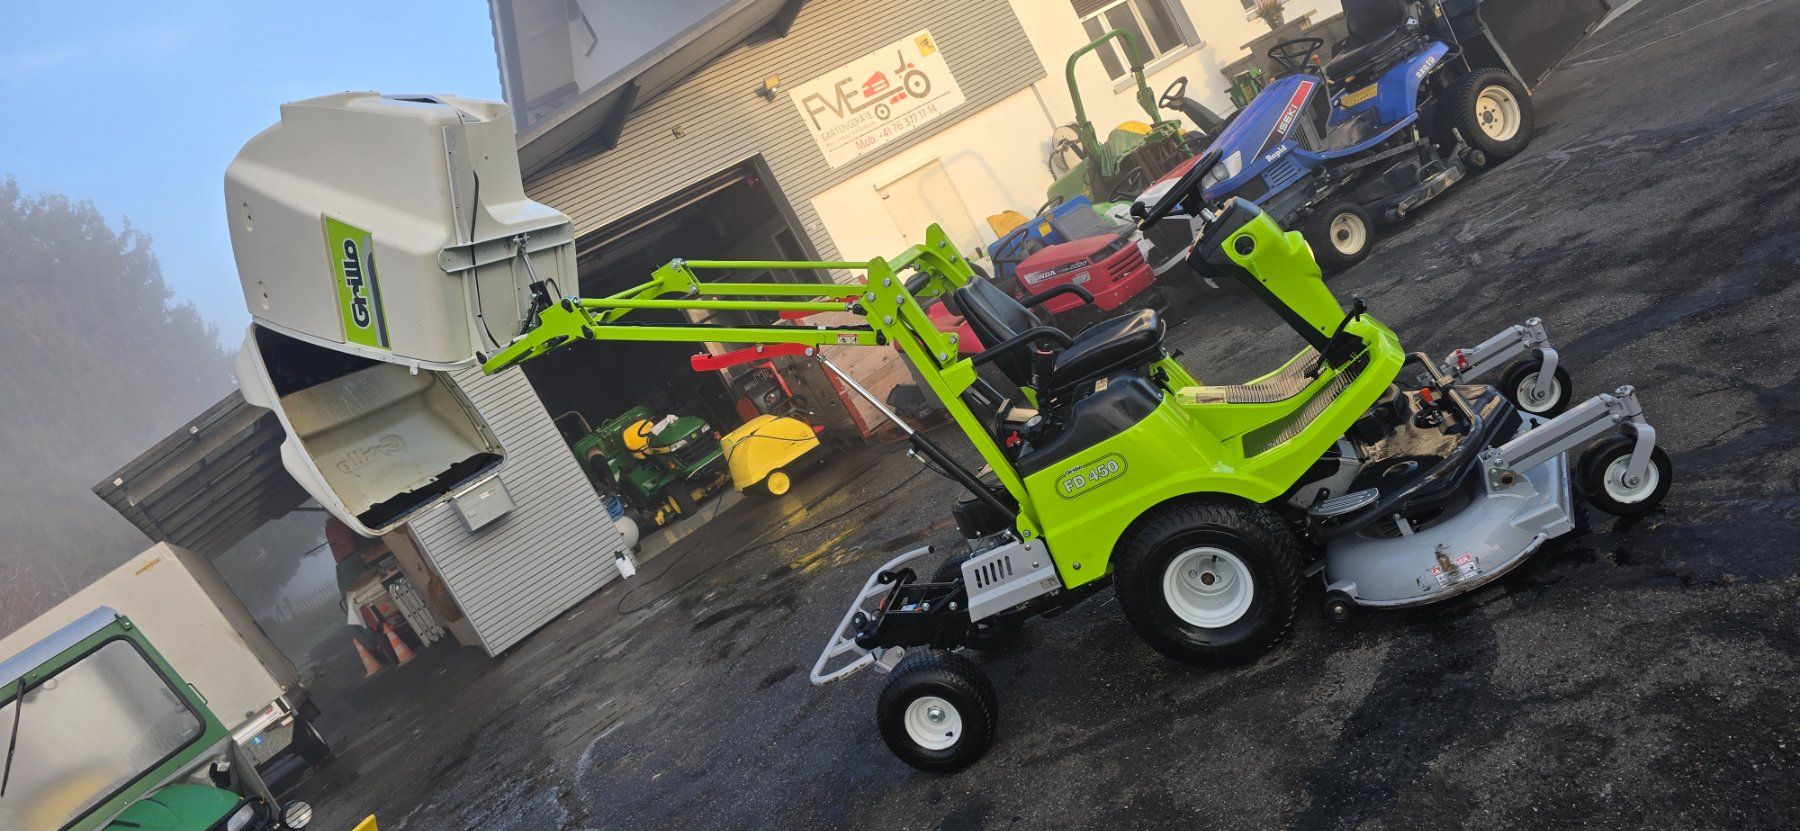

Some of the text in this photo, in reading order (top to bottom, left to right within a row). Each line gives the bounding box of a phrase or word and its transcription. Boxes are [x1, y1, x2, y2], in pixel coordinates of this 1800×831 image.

[801, 76, 859, 131] FVE
[1277, 104, 1298, 135] ISEKI
[855, 133, 879, 151] Mob.
[893, 120, 904, 132] 76
[1265, 144, 1288, 162] Rapid
[343, 239, 370, 328] Grillo
[1063, 460, 1119, 493] FD 450
